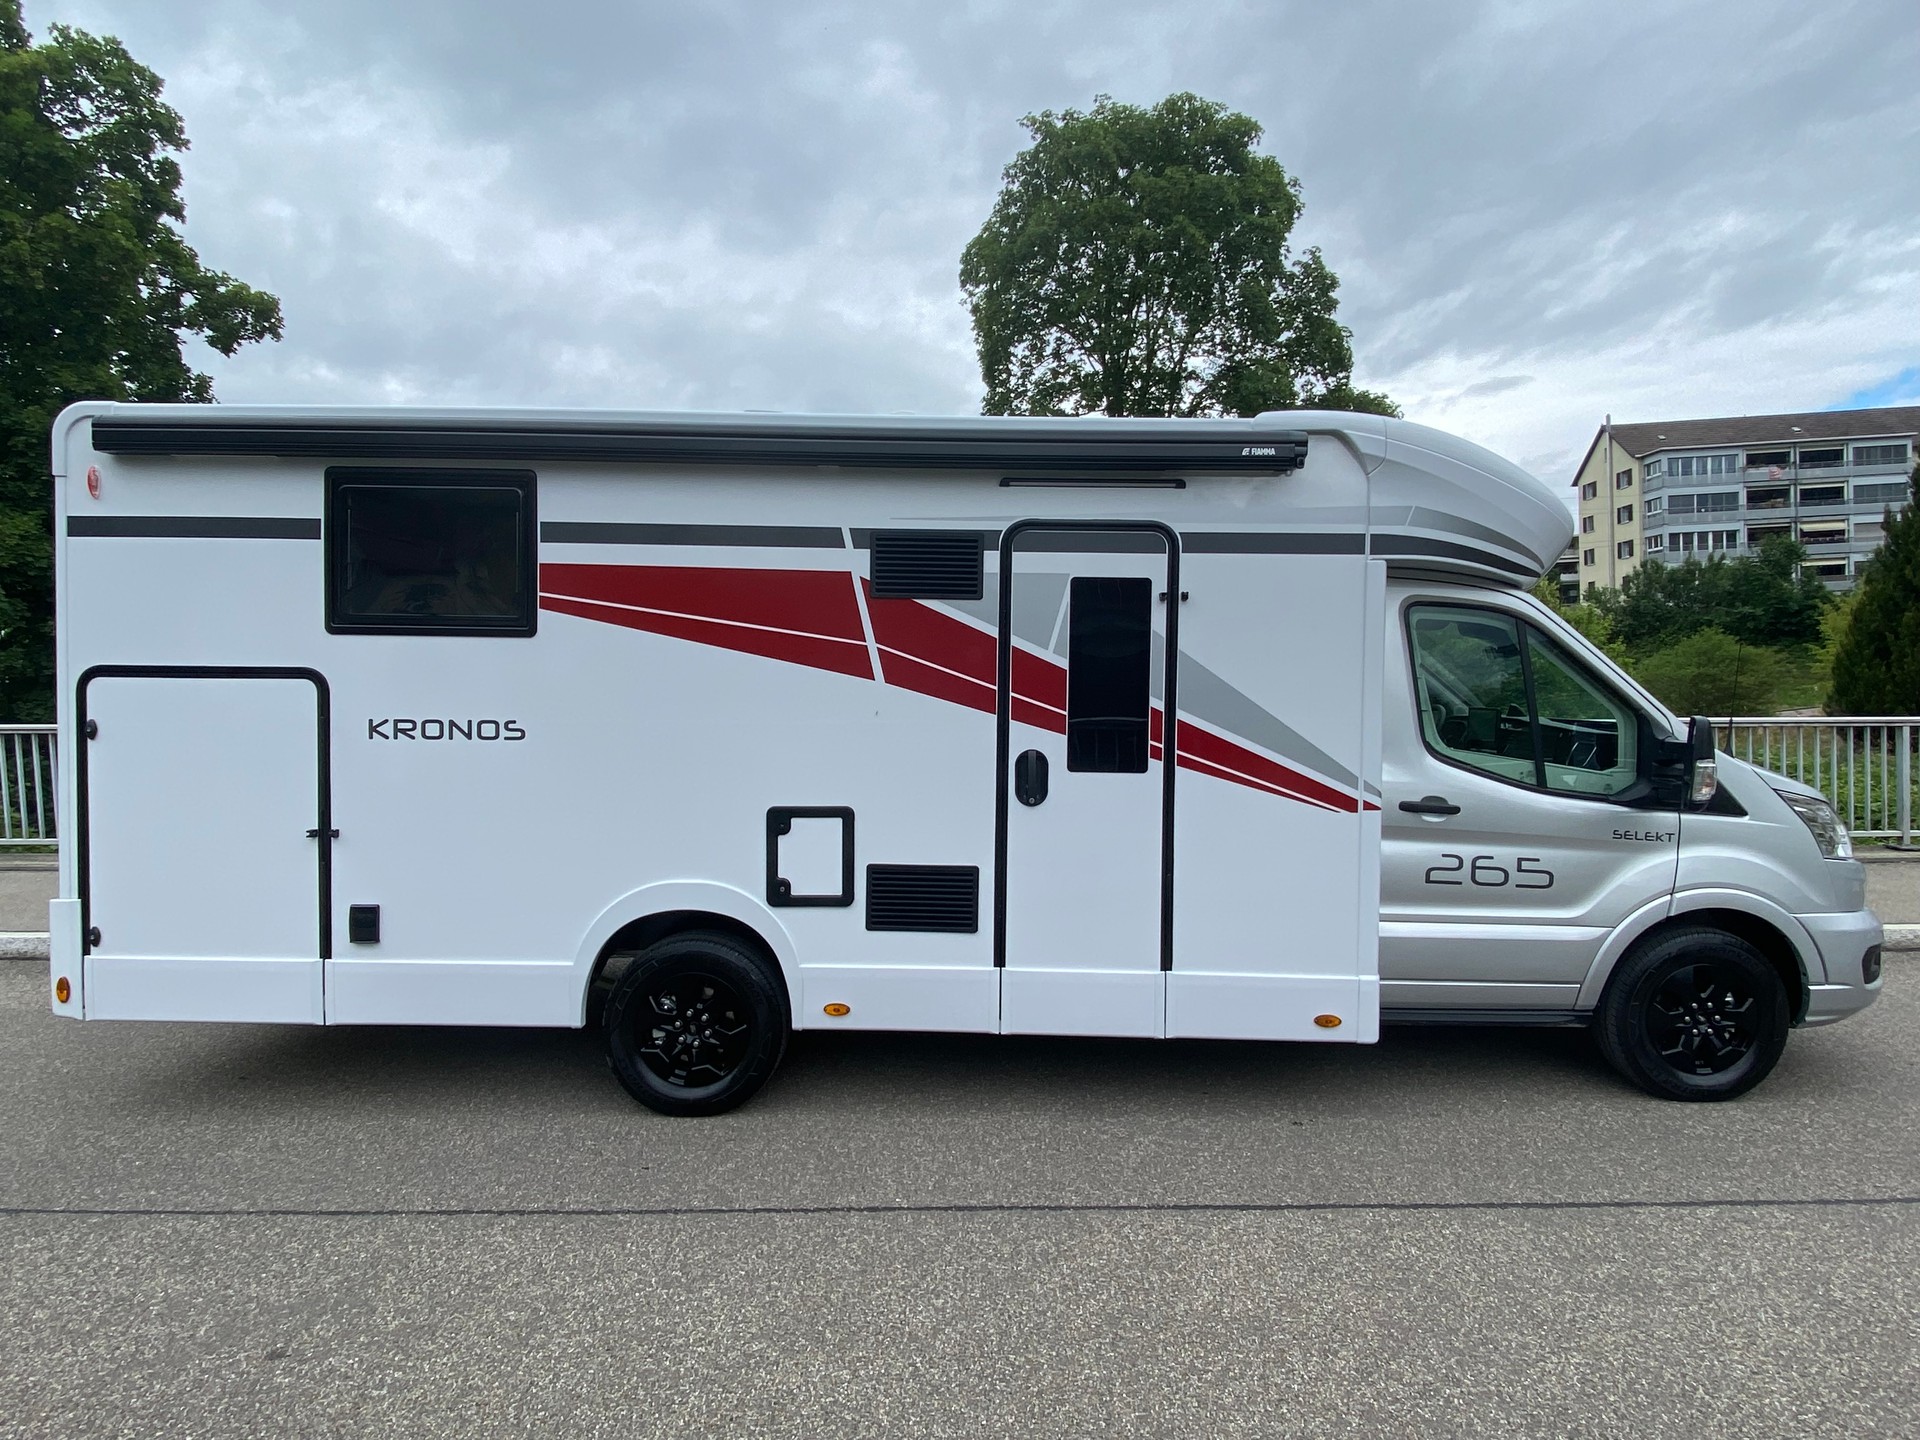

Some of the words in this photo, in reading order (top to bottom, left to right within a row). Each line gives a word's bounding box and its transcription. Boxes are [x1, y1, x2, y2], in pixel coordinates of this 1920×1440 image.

[1251, 447, 1276, 456] FIAMMA
[368, 718, 526, 741] KRONOS
[1612, 829, 1676, 843] SELEKT
[1425, 853, 1555, 889] 265
